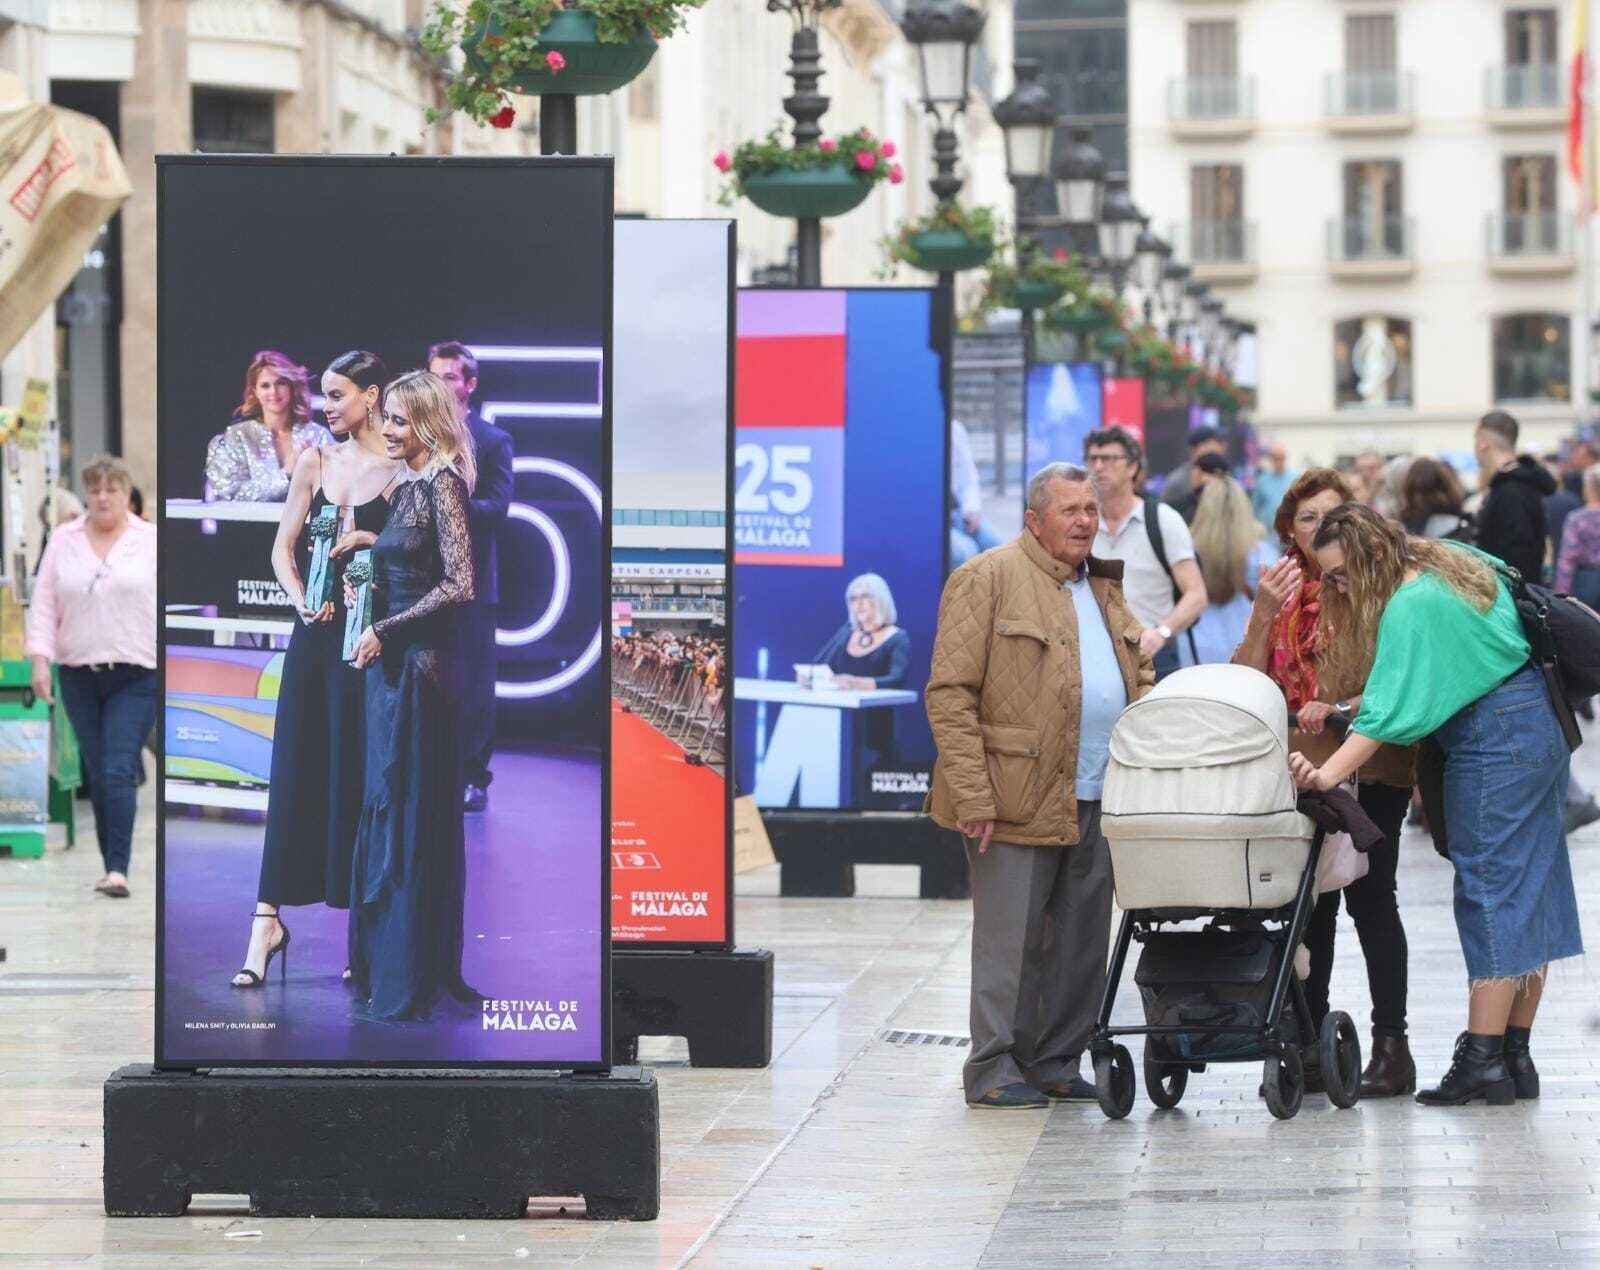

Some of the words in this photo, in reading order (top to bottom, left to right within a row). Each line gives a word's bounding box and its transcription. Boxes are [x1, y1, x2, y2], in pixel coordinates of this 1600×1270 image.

[735, 442, 812, 515] 25
[735, 515, 790, 529] ESTIVAL
[631, 891, 688, 901] FESTIVAL
[692, 891, 708, 901] DE
[631, 900, 708, 917] MÁLAGA
[482, 999, 553, 1012] FESTIVAL
[559, 1000, 578, 1012] DE
[184, 1022, 209, 1030] MILENA
[482, 1010, 578, 1031] MÁLAGA
